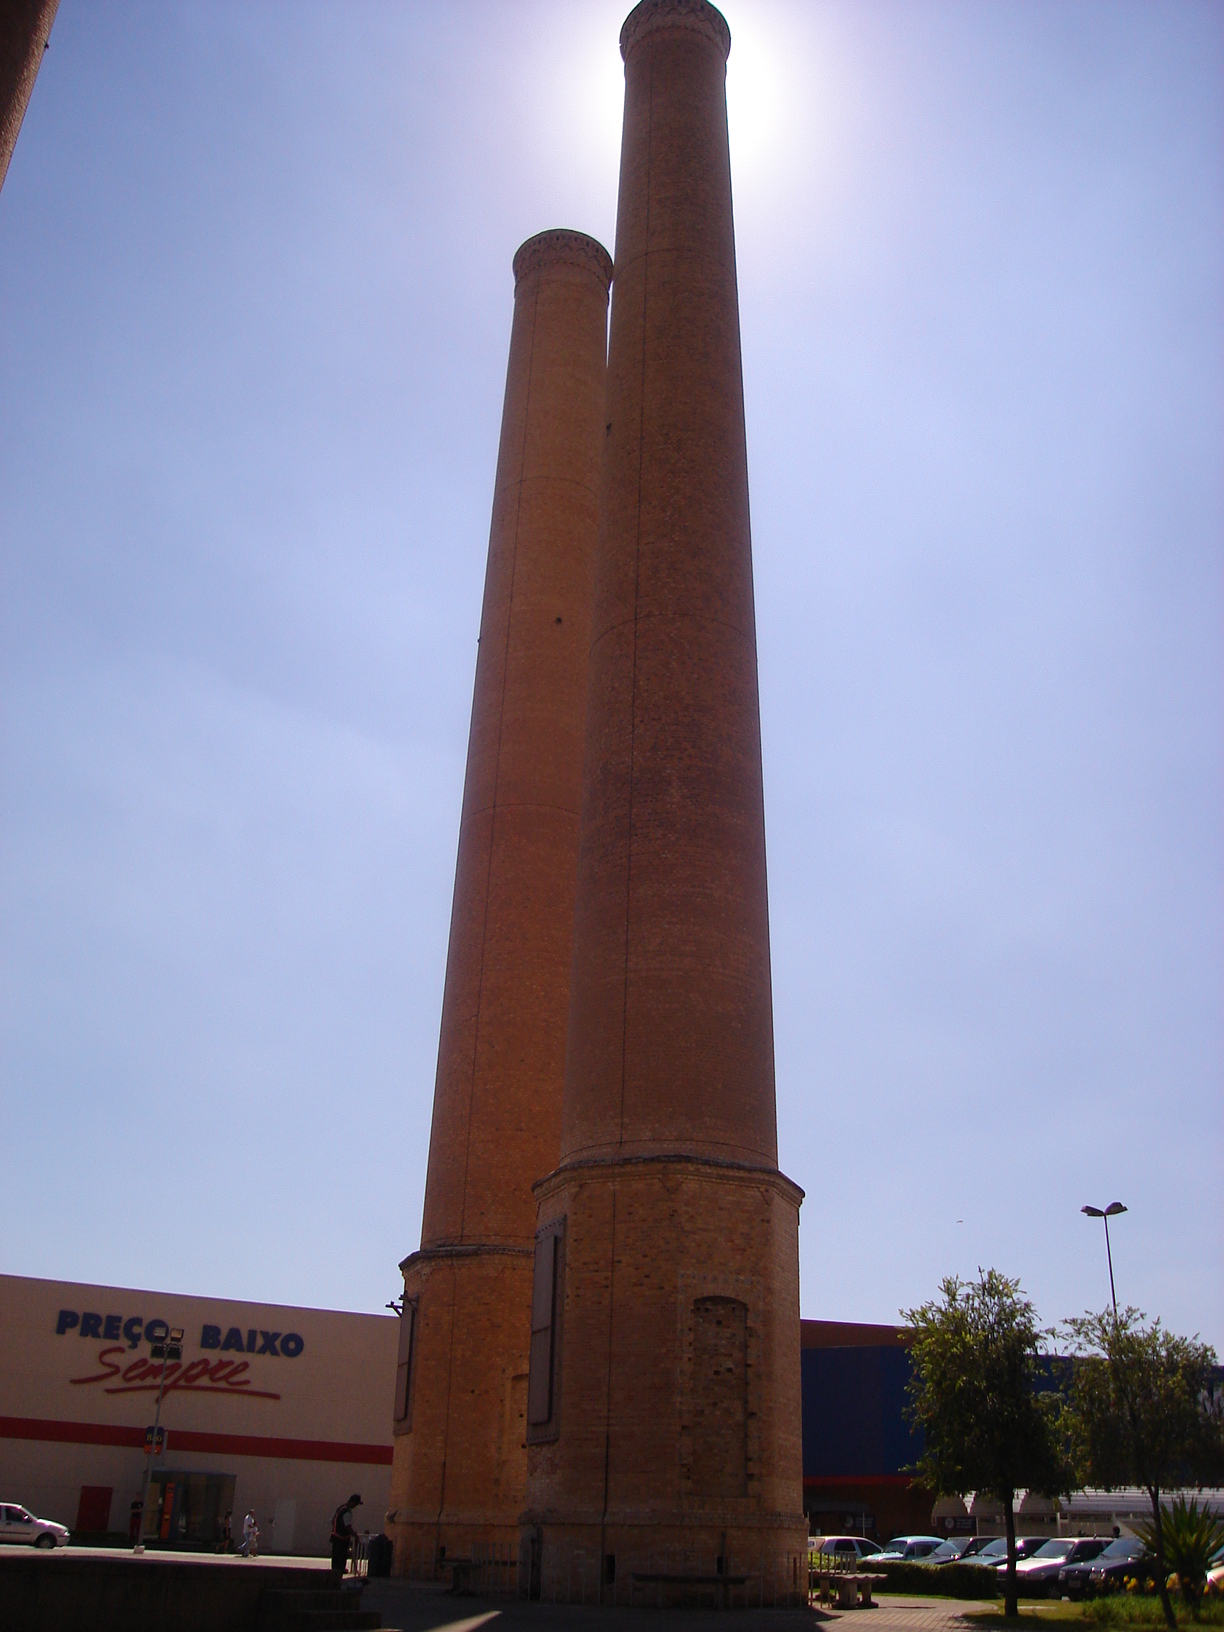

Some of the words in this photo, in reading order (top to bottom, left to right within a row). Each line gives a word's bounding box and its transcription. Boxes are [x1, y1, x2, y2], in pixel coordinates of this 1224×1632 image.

[56, 1310, 169, 1349] PREÇO
[200, 1325, 304, 1357] BAIXO
[70, 1347, 251, 1404] Sempre
